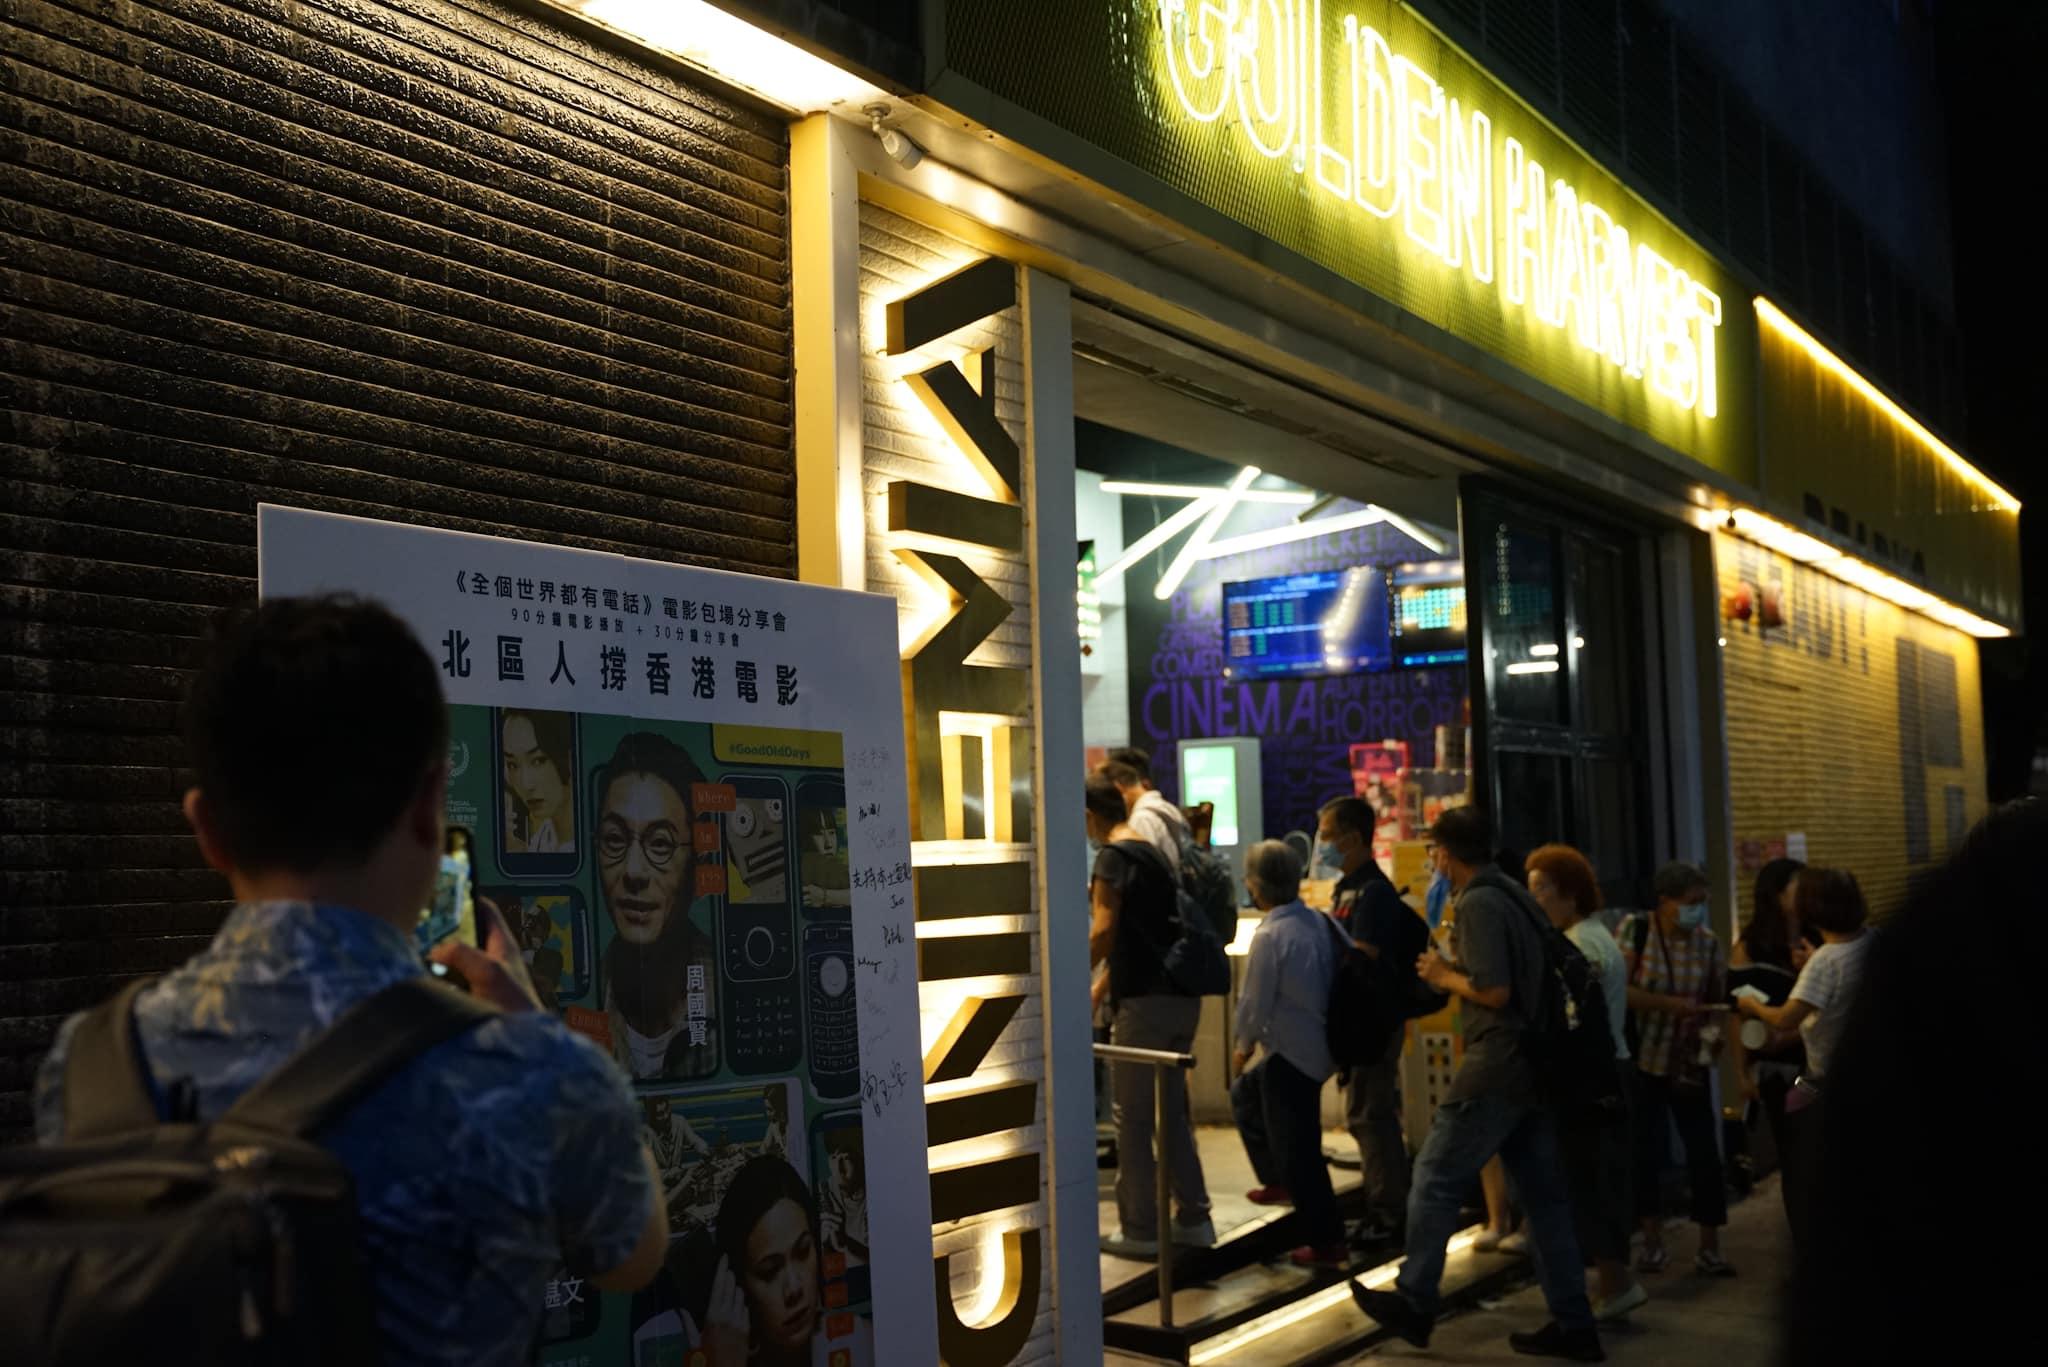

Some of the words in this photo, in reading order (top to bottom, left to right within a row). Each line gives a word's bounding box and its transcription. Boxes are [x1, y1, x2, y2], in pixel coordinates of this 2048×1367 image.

[1163, 0, 1494, 284] GOLDEN
[1505, 136, 1722, 420] HARVEST
[456, 570, 787, 633] 《全個世界都有電話》電影包場分享會
[442, 629, 799, 706] 北區人撐香港電影
[1142, 679, 1317, 740] CINEMA
[729, 743, 811, 761] #GoodOldDays
[887, 257, 1042, 1367] CINEMA
[687, 965, 707, 1047] 周國賢
